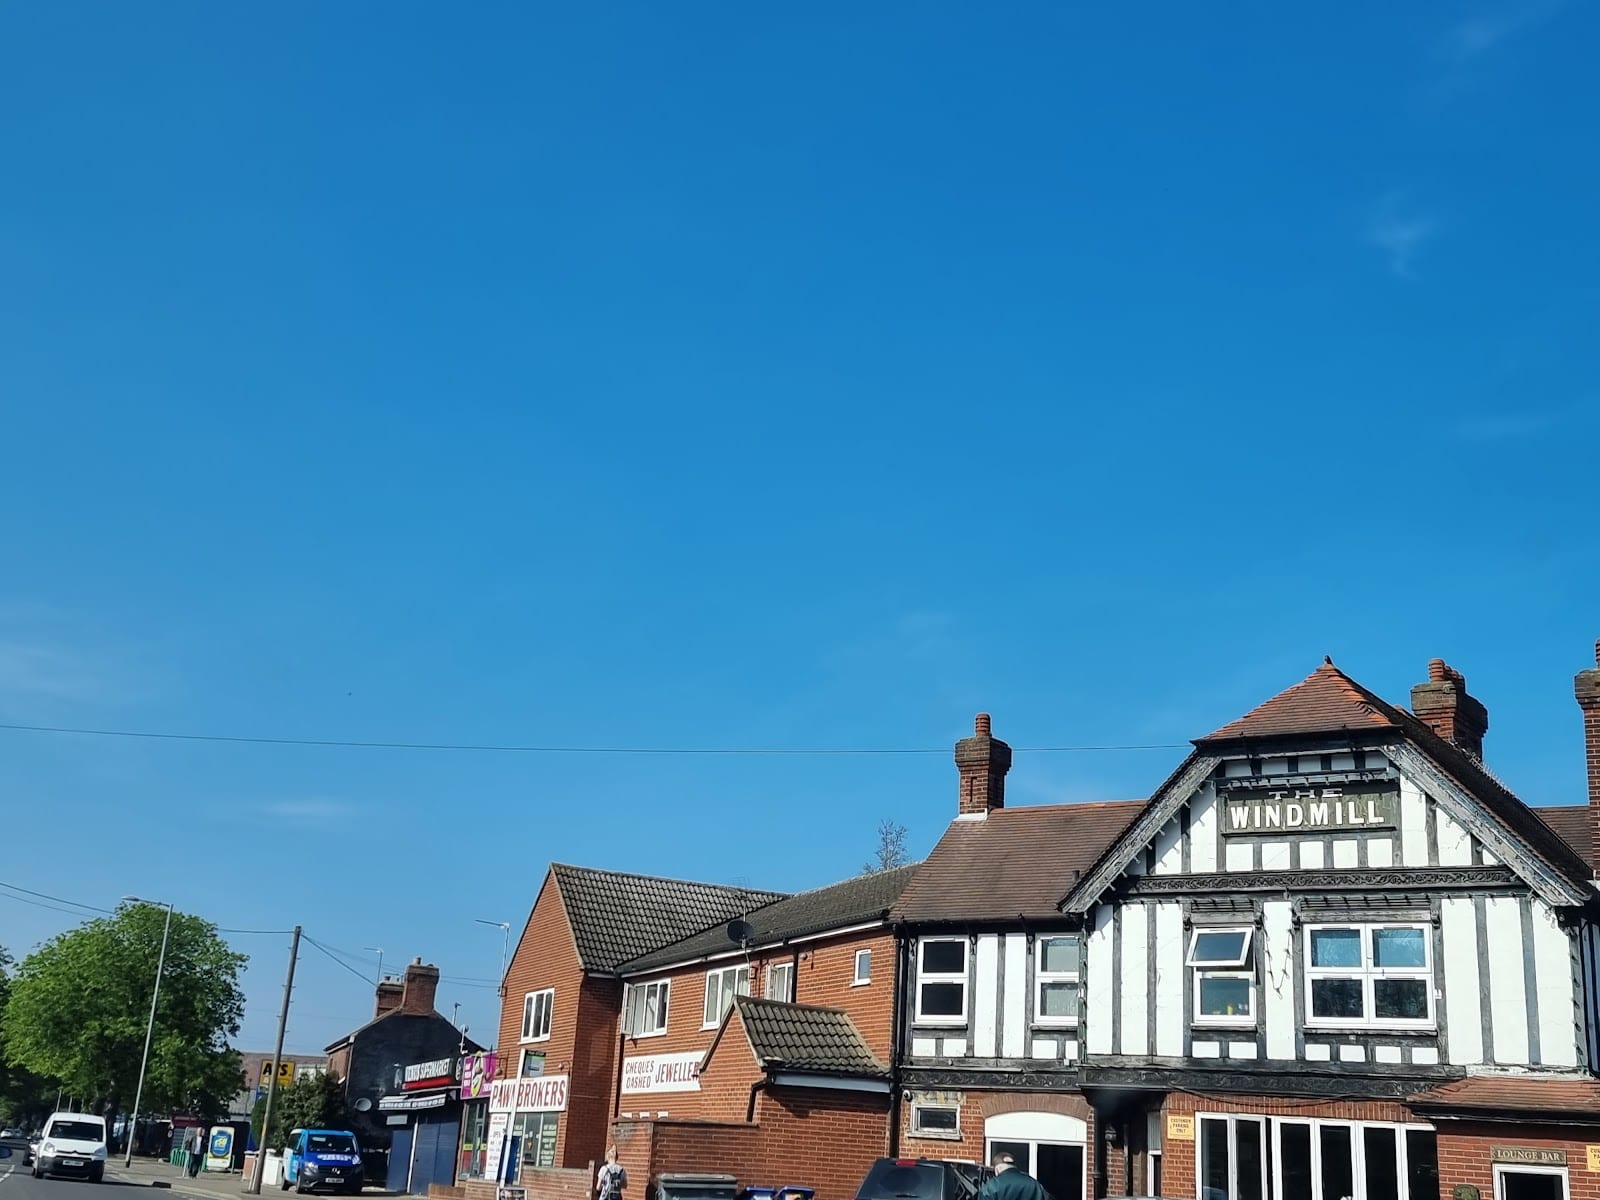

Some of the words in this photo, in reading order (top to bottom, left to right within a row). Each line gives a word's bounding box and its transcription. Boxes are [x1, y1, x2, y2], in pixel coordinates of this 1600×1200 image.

[1268, 788, 1343, 800] THE
[1230, 801, 1385, 829] WINDMILL
[625, 1060, 655, 1075] CHEQUES
[1497, 1149, 1538, 1160] LOUNGE
[1541, 1151, 1561, 1161] BAR
